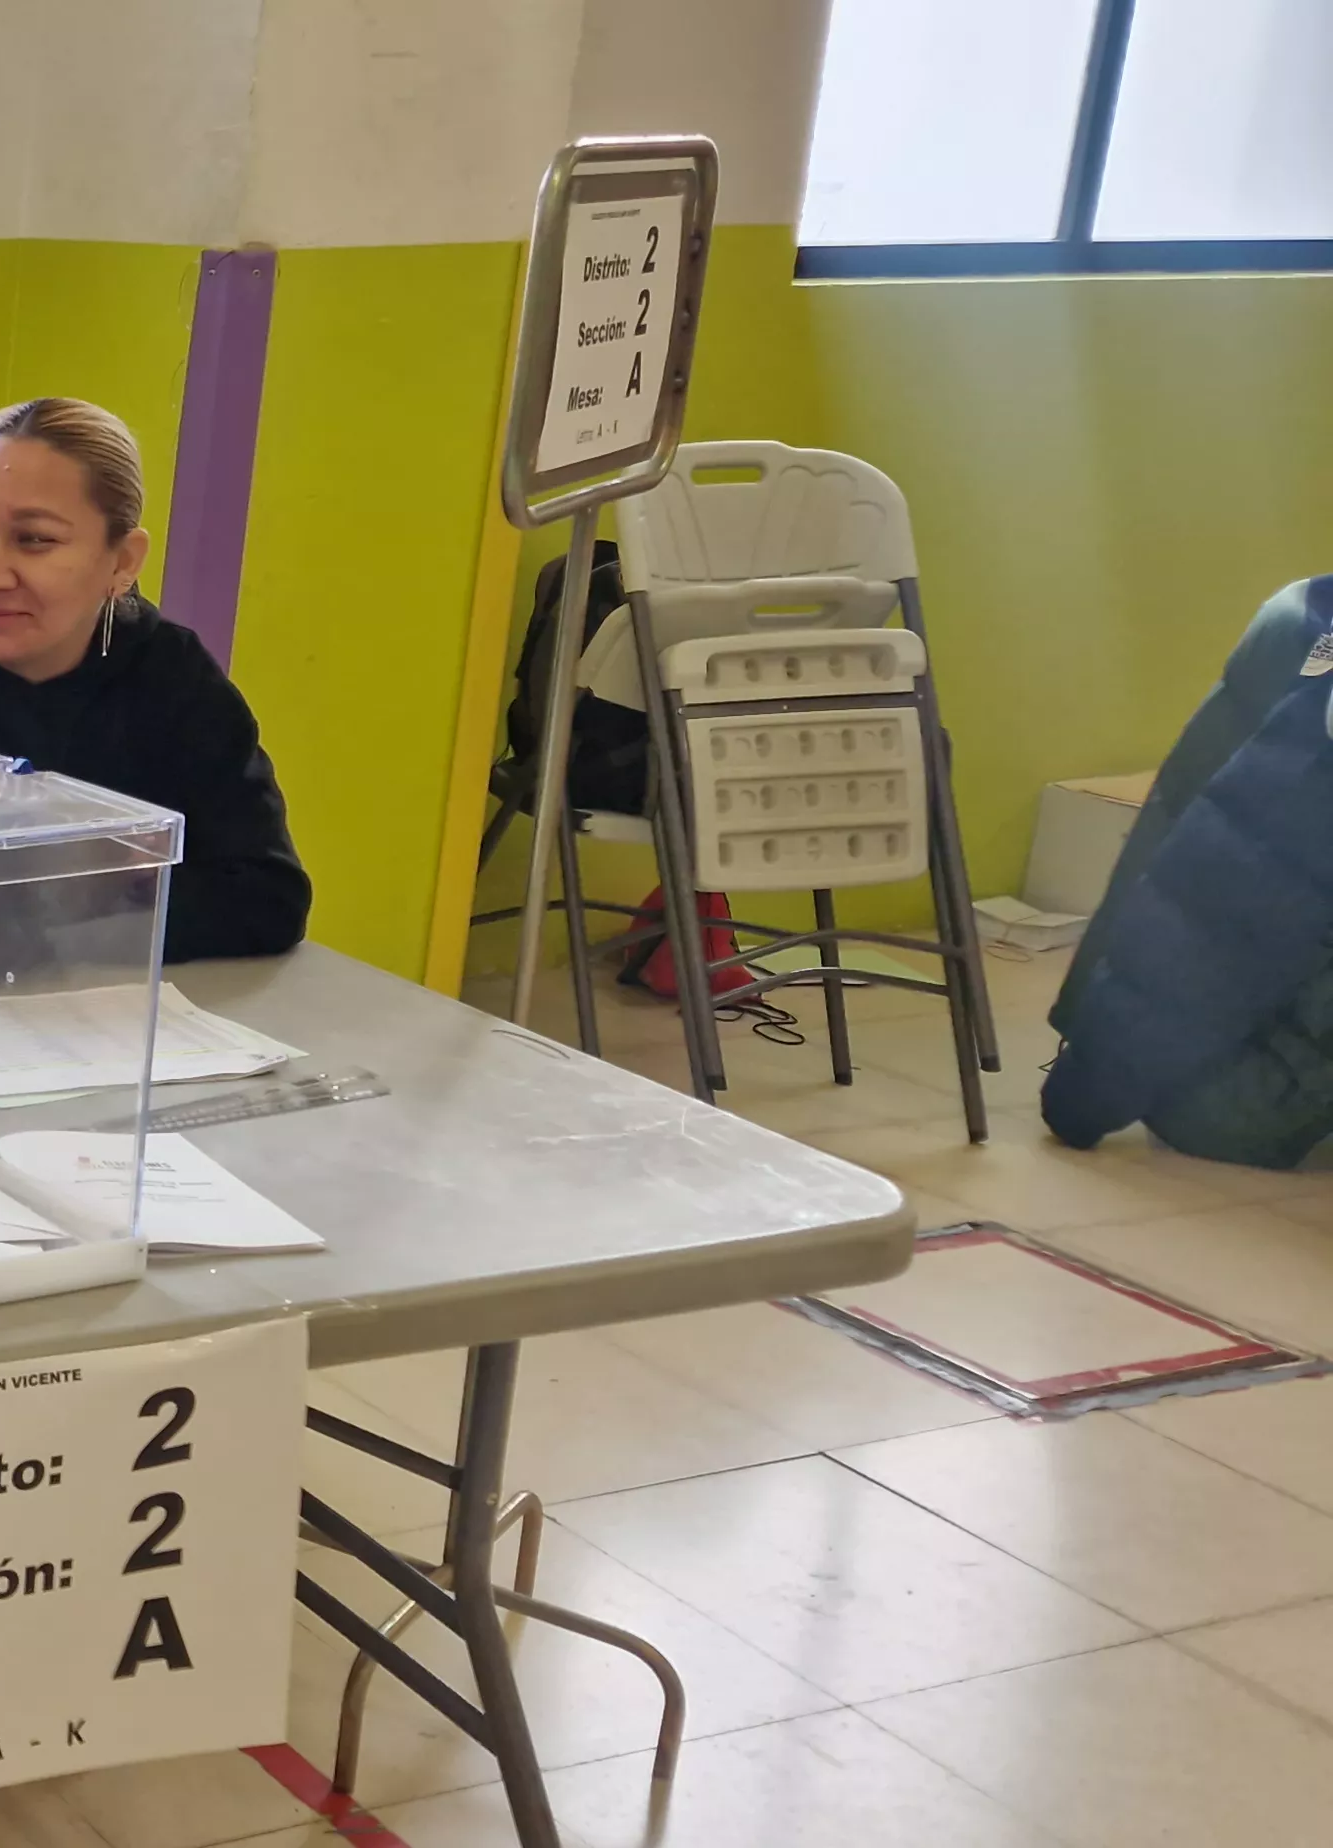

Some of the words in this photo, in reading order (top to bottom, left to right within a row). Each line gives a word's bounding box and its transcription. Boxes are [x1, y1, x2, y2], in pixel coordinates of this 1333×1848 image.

[583, 254, 631, 283] Distrito:
[641, 225, 659, 274] 2
[578, 315, 627, 348] Sección:
[633, 288, 651, 337] 2
[567, 385, 604, 413] Mesa:
[626, 351, 642, 398] A
[11, 1369, 82, 1389] VICENTE
[132, 1386, 196, 1472] 2
[122, 1491, 185, 1575] 2
[113, 1596, 193, 1680] A
[67, 1719, 86, 1746] K
